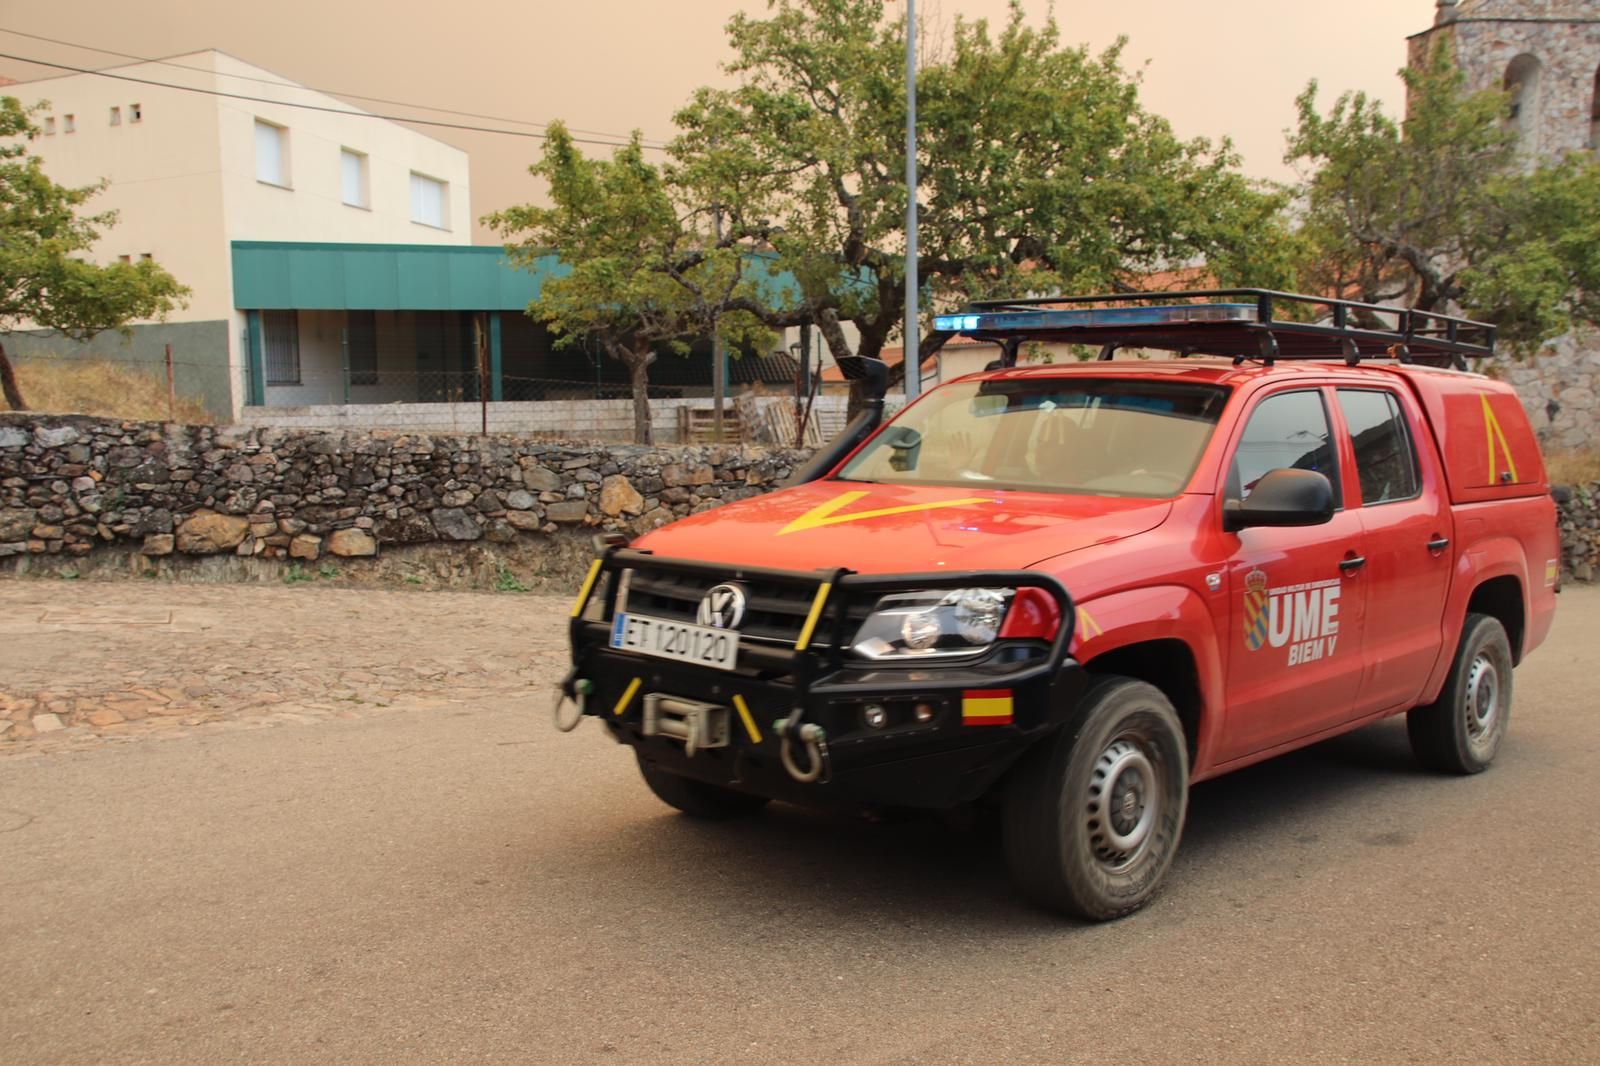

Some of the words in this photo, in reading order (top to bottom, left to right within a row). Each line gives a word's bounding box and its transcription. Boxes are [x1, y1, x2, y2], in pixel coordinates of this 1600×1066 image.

[1268, 586, 1340, 648] UME
[1287, 638, 1325, 666] BIEM
[1327, 635, 1338, 657] V
